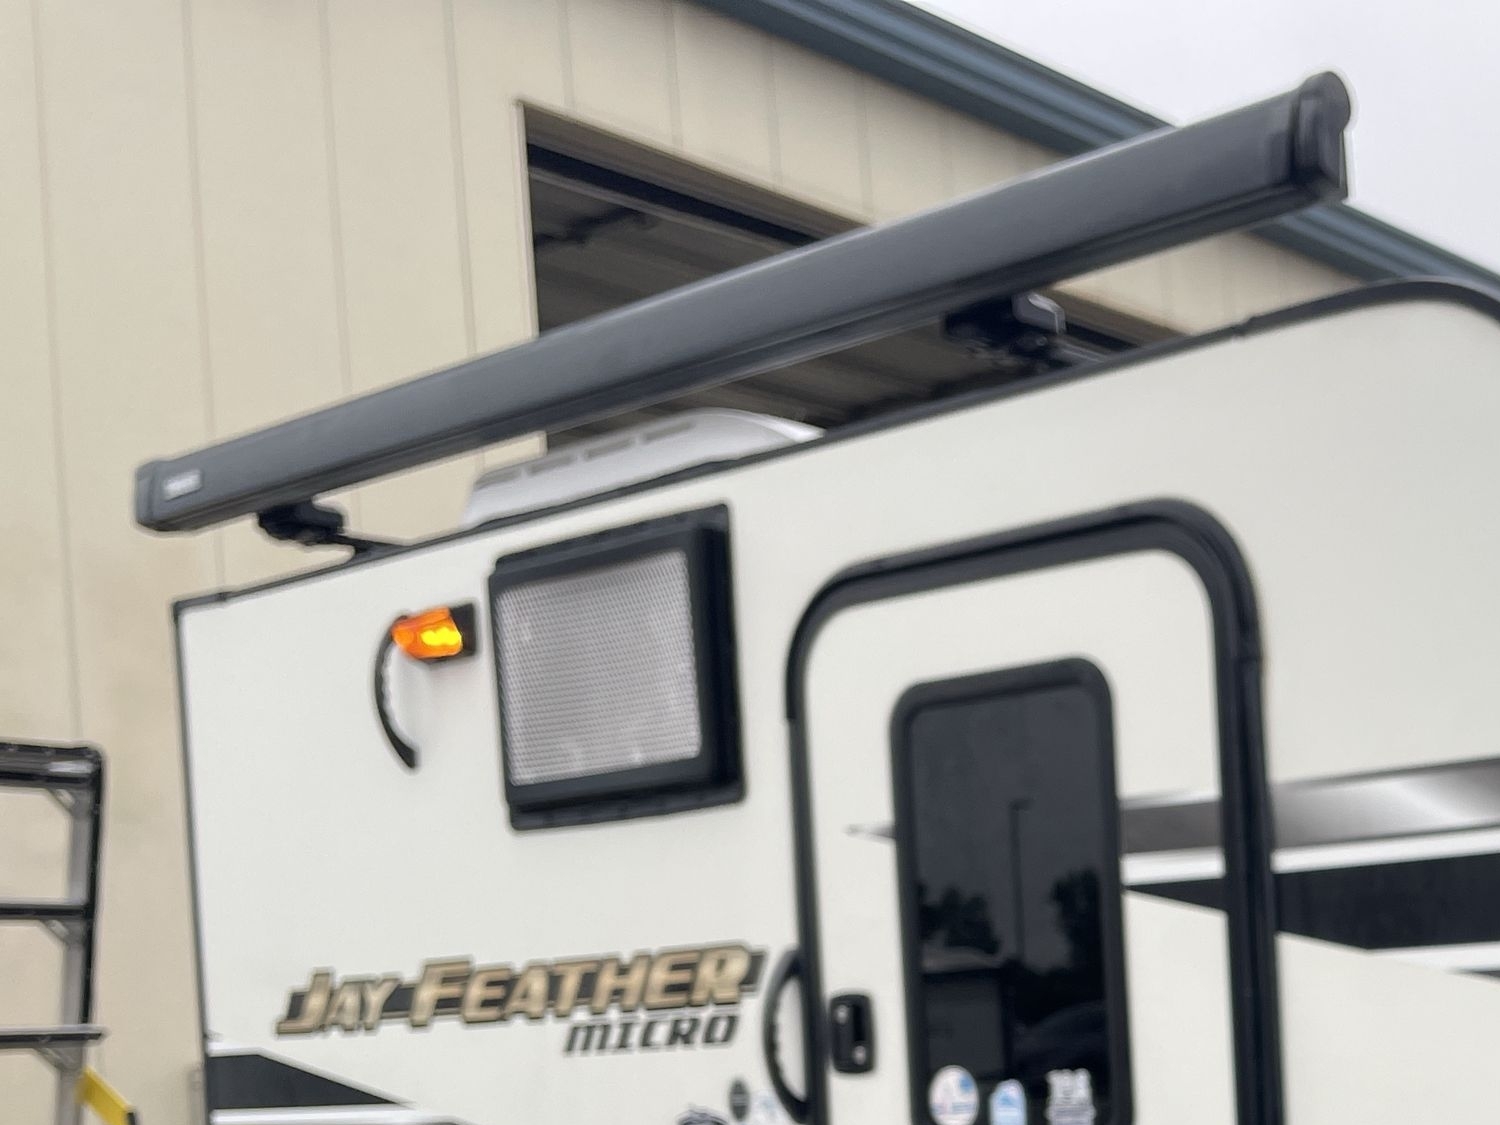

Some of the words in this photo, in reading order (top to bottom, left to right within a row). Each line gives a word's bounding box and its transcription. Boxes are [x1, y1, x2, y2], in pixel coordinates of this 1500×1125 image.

[276, 966, 401, 1034] JAY
[409, 943, 750, 1028] FEATHER
[563, 1014, 739, 1053] MICRO
